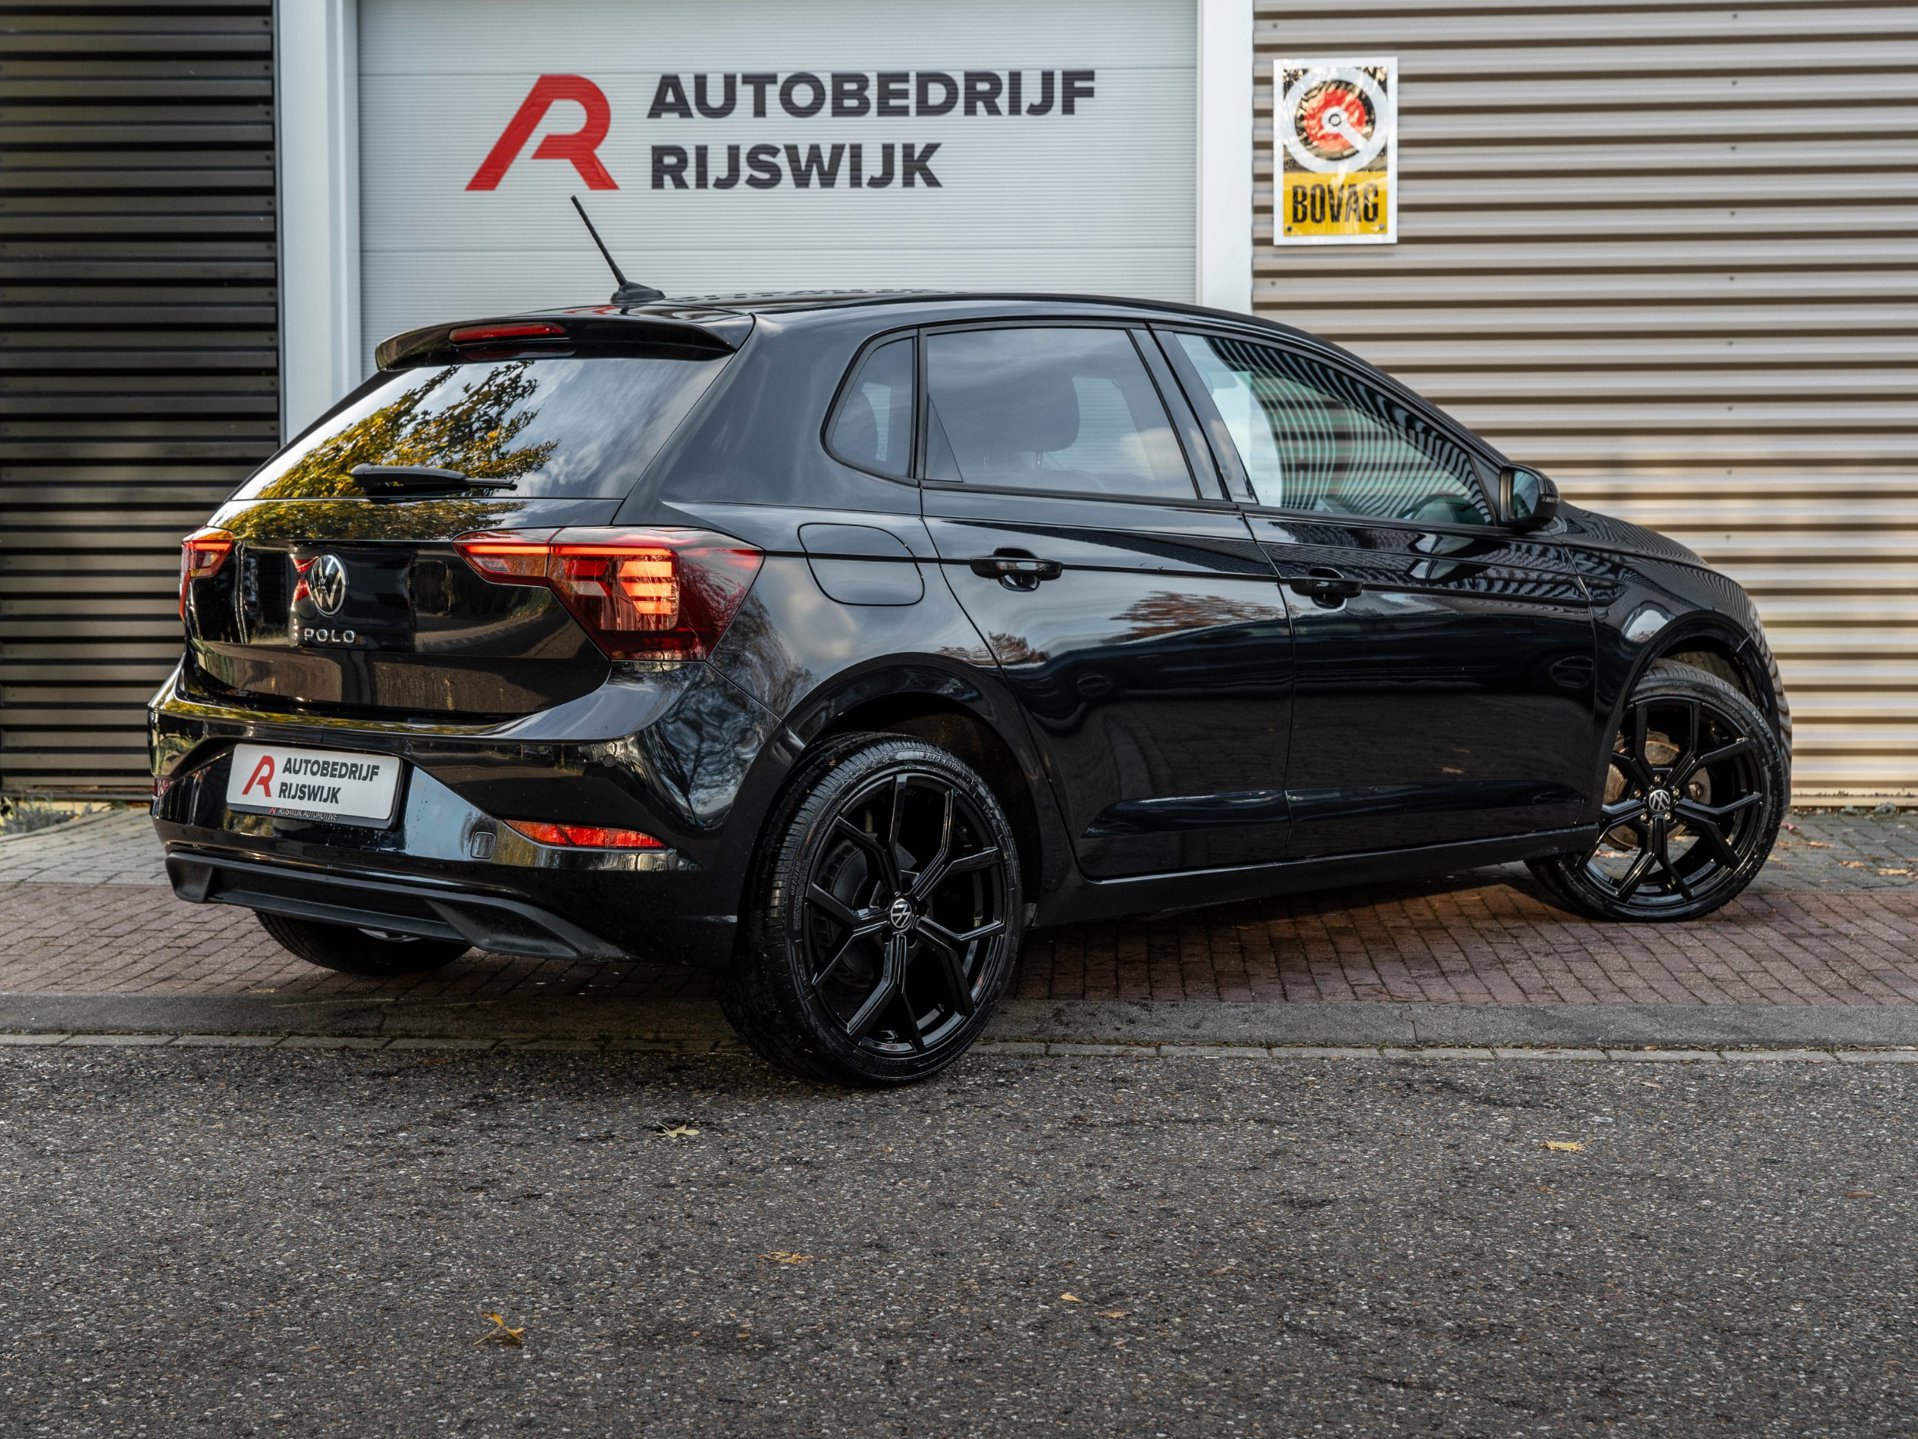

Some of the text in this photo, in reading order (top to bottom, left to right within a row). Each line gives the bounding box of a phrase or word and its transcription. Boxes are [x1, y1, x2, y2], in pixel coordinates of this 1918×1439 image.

[647, 70, 1096, 119] AUTOBEDRIJF
[651, 142, 943, 189] RIJSWIJK
[1292, 183, 1379, 223] BOVAG
[304, 627, 356, 643] POLO
[282, 757, 380, 782] AUTOBEDRIJF
[278, 782, 341, 804] RIJSWIJK
